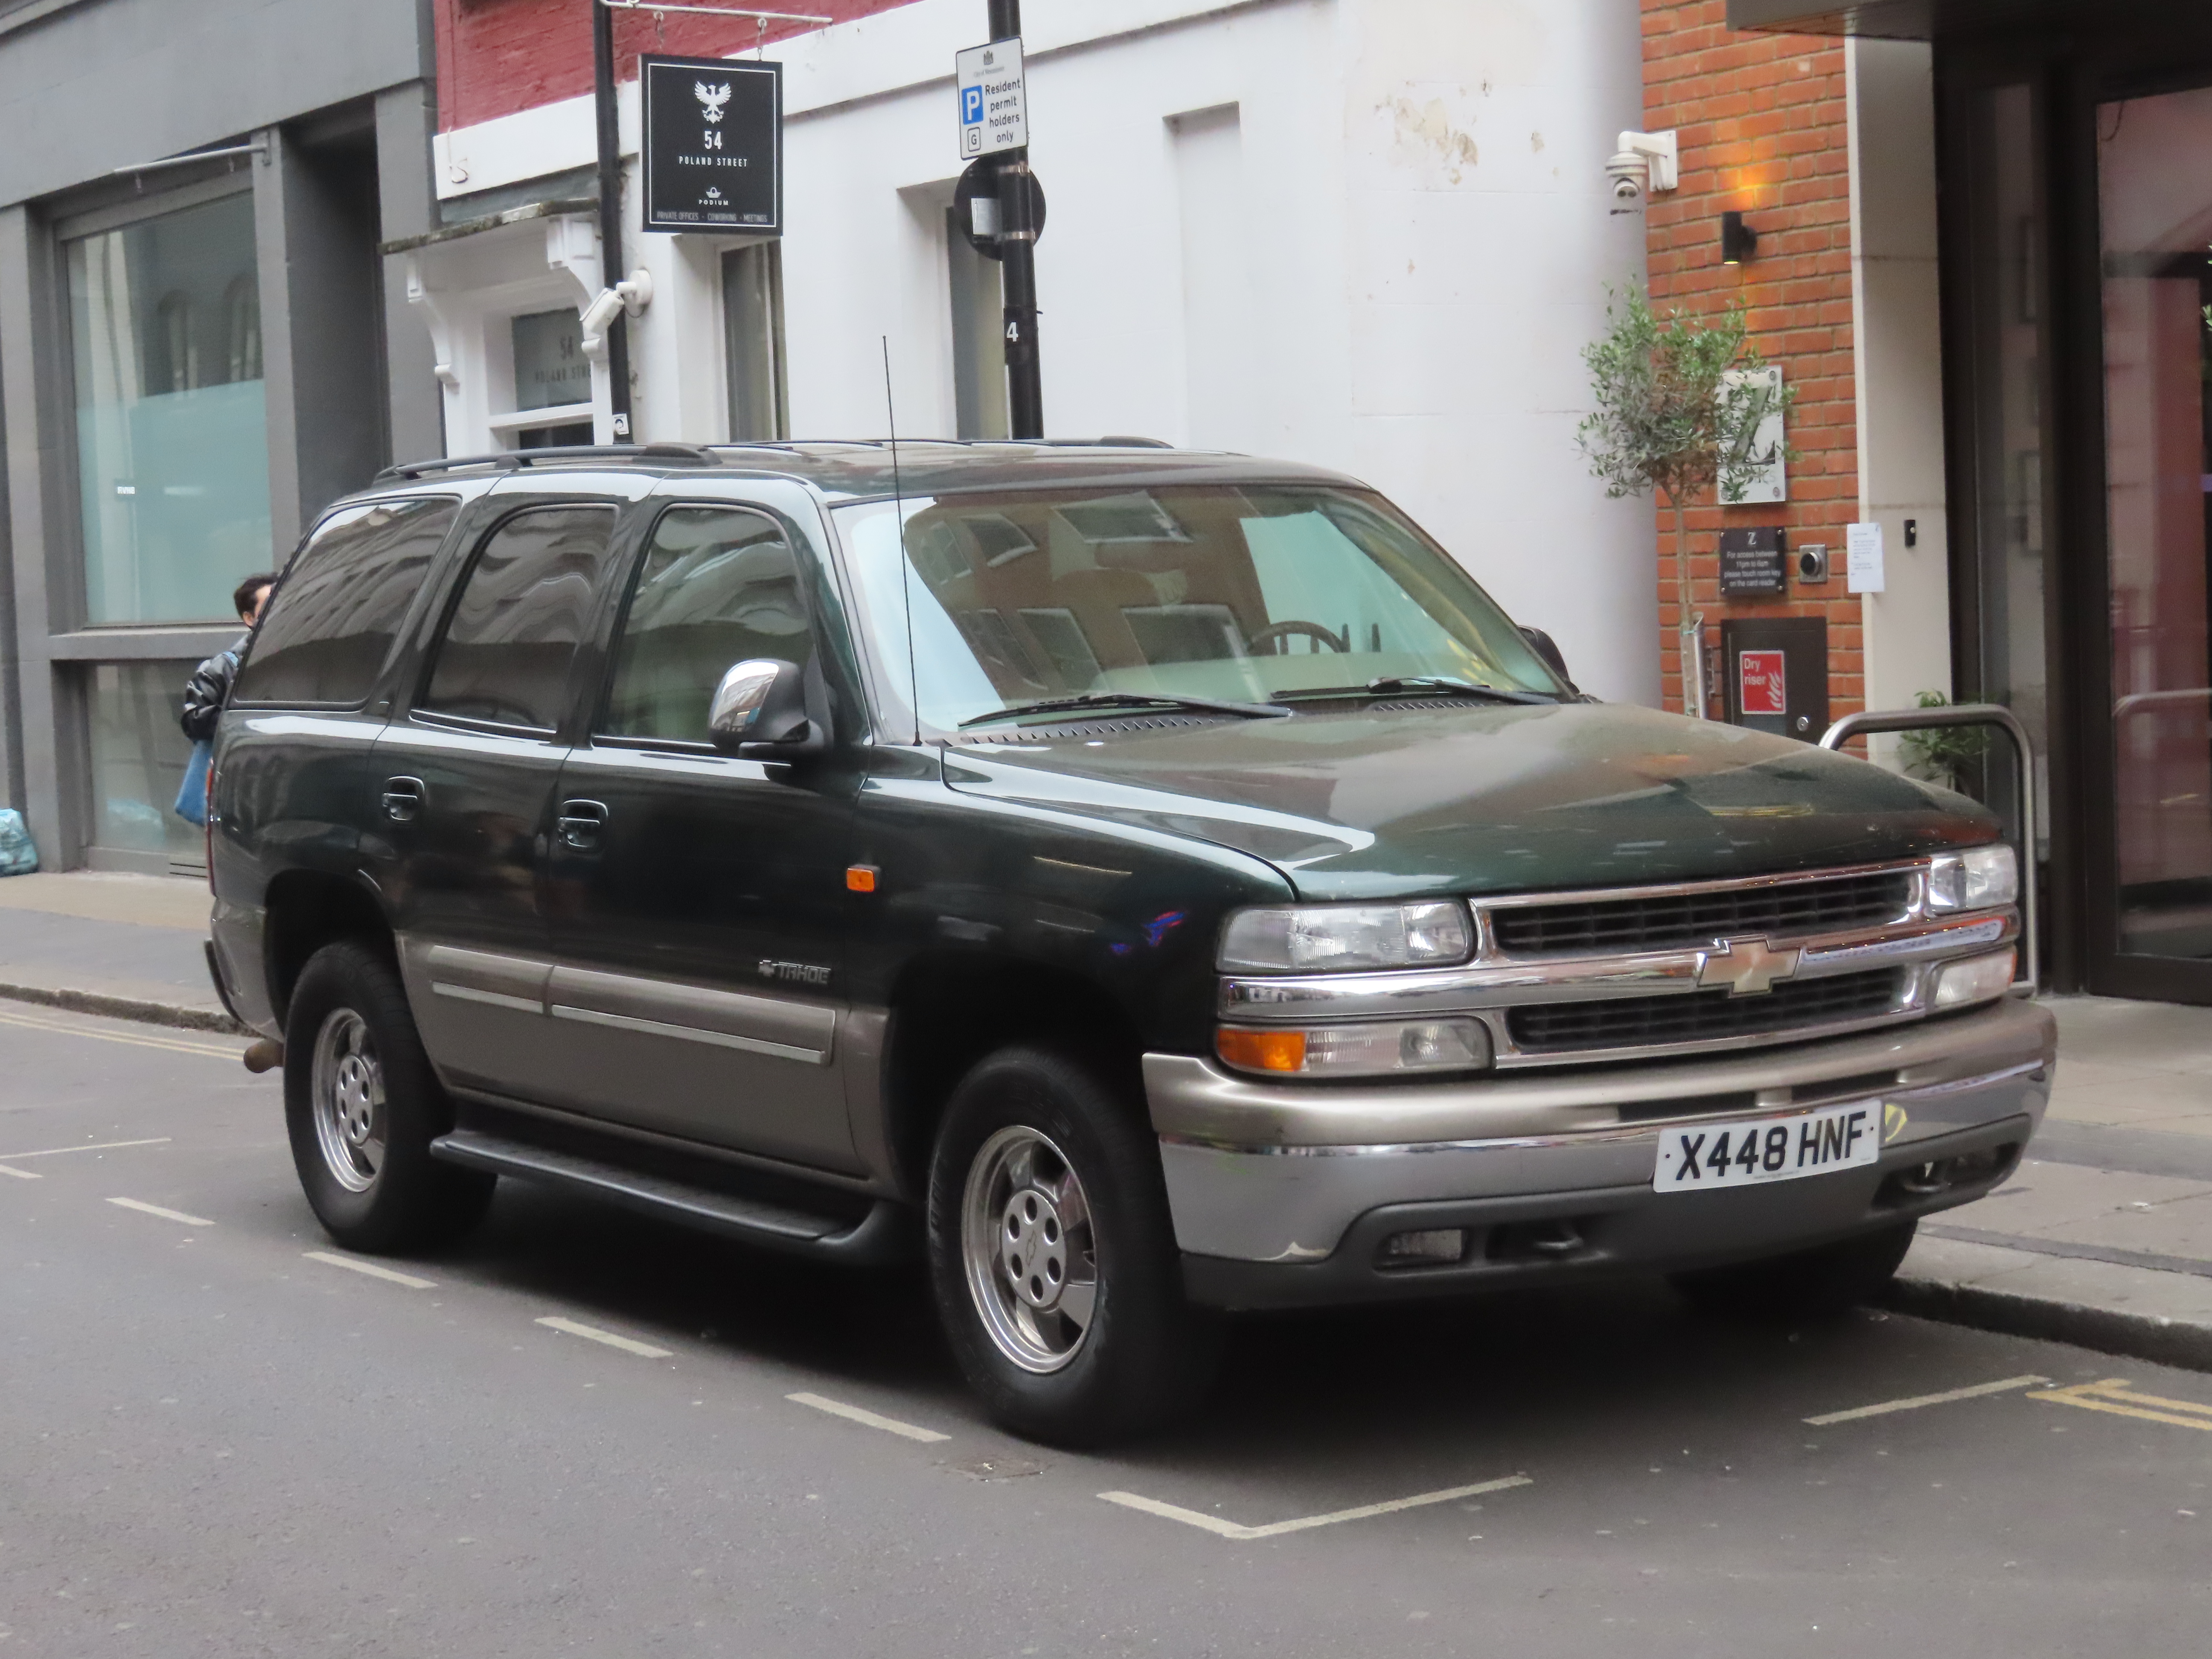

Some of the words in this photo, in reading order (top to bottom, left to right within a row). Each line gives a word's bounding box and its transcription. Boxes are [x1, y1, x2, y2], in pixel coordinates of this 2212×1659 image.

[985, 78, 1021, 96] Resident
[966, 90, 980, 121] P
[990, 96, 1017, 113] permit
[989, 114, 1020, 128] holders
[704, 130, 723, 150] 54
[971, 134, 977, 145] G
[996, 131, 1014, 143] only
[679, 156, 712, 166] POLAND
[717, 157, 748, 168] STREET
[656, 211, 677, 221] PRIVATE
[678, 212, 699, 221] OFFICES
[743, 214, 768, 223] MEETINGS
[1006, 322, 1019, 342] 4
[1747, 532, 1757, 545] Z
[1771, 569, 1781, 577] key
[1744, 658, 1761, 672] Dry
[1744, 673, 1767, 685] riser
[778, 961, 831, 985] TAHOE
[1676, 1125, 1788, 1181] X448
[1797, 1110, 1867, 1167] HNF
